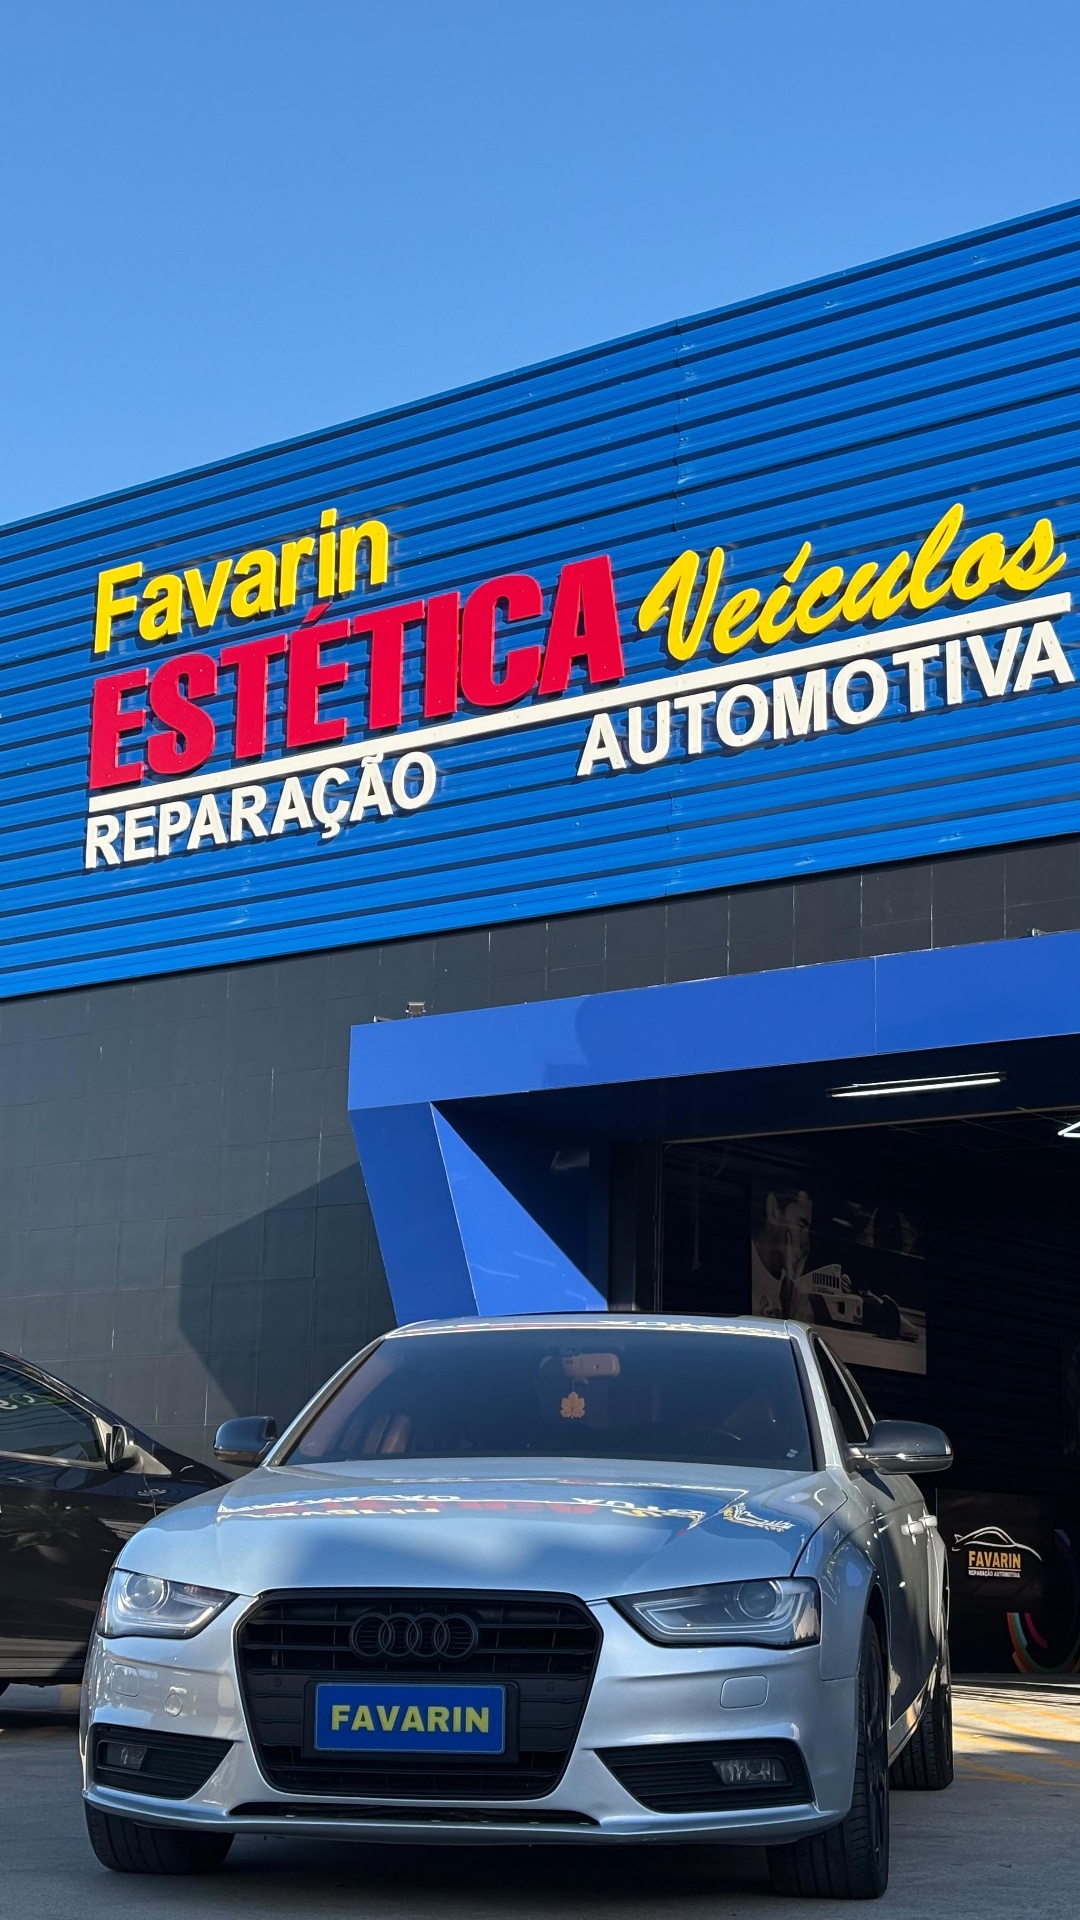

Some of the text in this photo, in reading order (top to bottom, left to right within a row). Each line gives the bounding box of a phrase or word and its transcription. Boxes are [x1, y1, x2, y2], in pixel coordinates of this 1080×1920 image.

[94, 508, 389, 653] Favarin
[637, 503, 1067, 661] Veículos
[84, 620, 1076, 870] REPARAÇÃO AUTOMOTIVA
[89, 554, 626, 790] ESTÉTICA
[968, 1550, 1021, 1569] FAVARIN
[331, 1704, 489, 1733] FAVARIN
